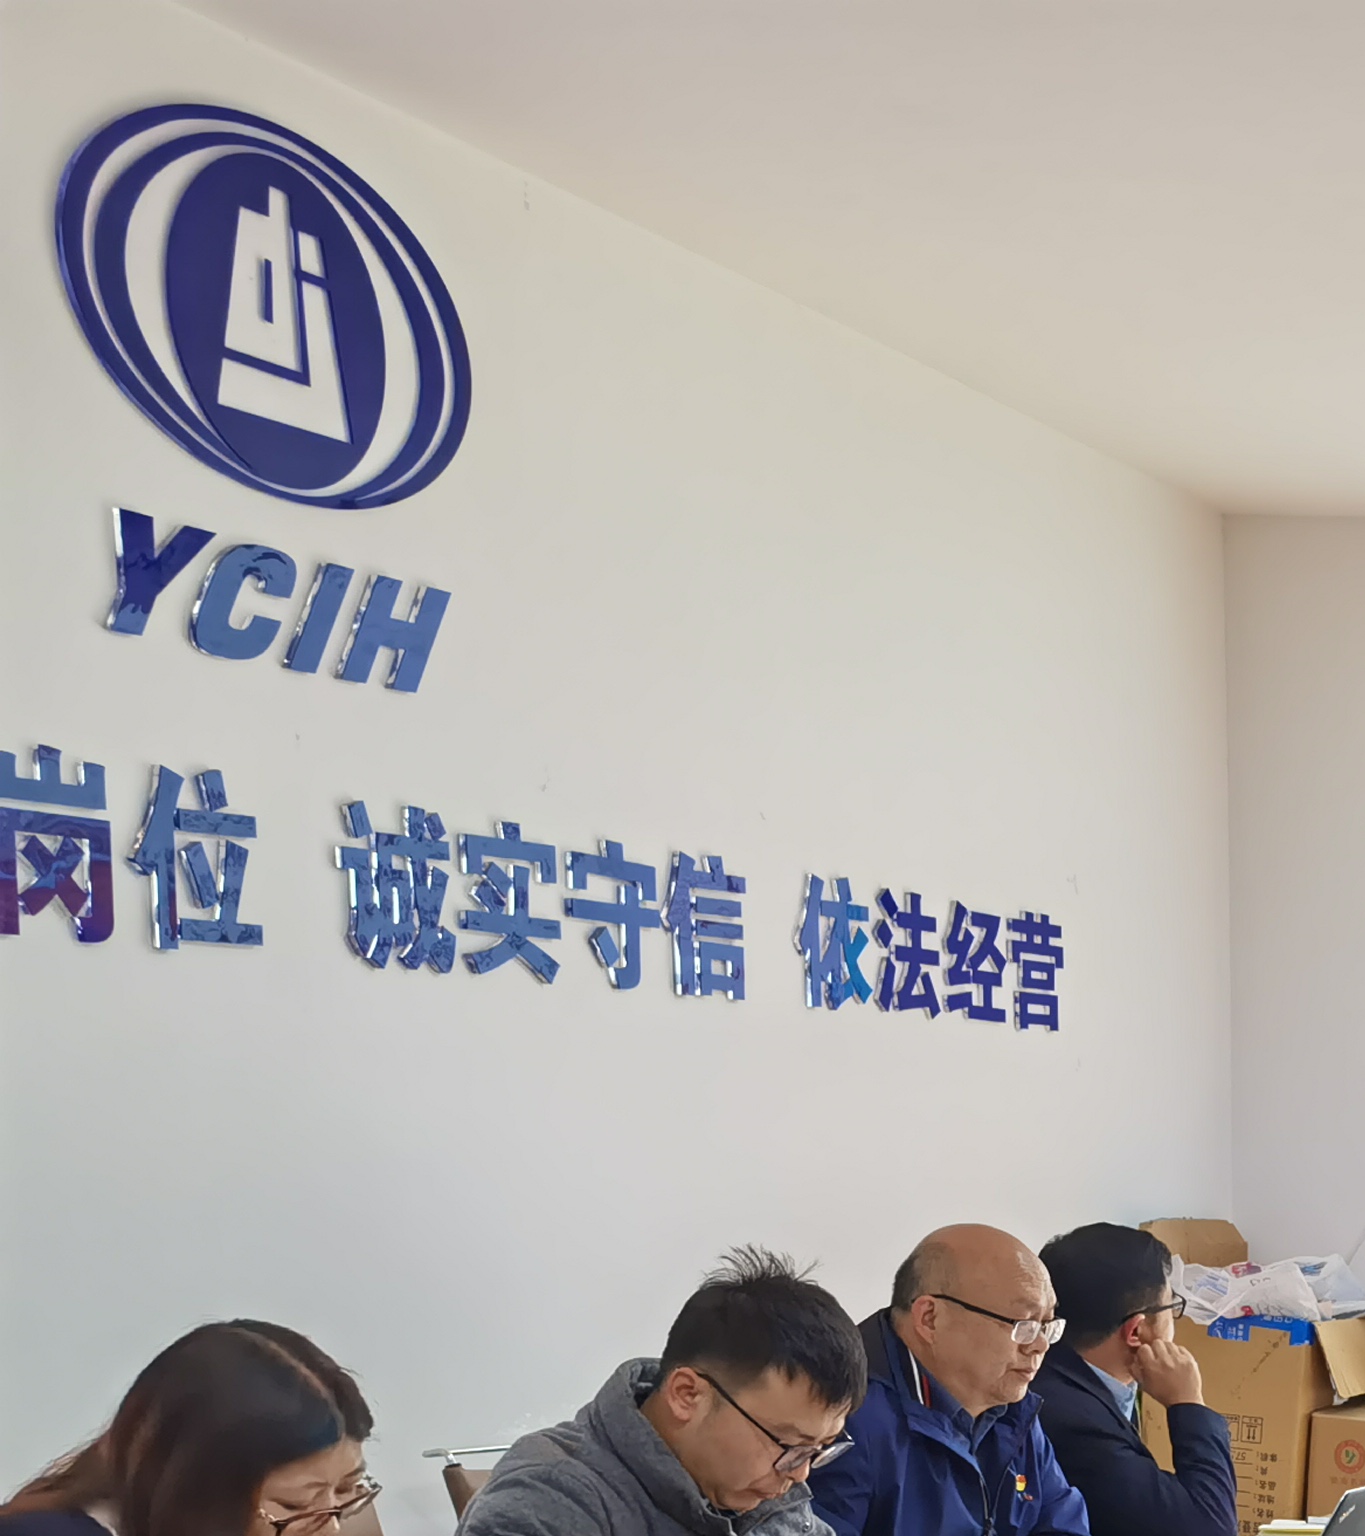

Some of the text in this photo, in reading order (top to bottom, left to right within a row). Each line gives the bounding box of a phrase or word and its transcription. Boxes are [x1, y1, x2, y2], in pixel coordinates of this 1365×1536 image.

[102, 506, 451, 692] YCIH
[335, 801, 747, 999] 诚实守信
[793, 872, 1065, 1031] 依法经营
